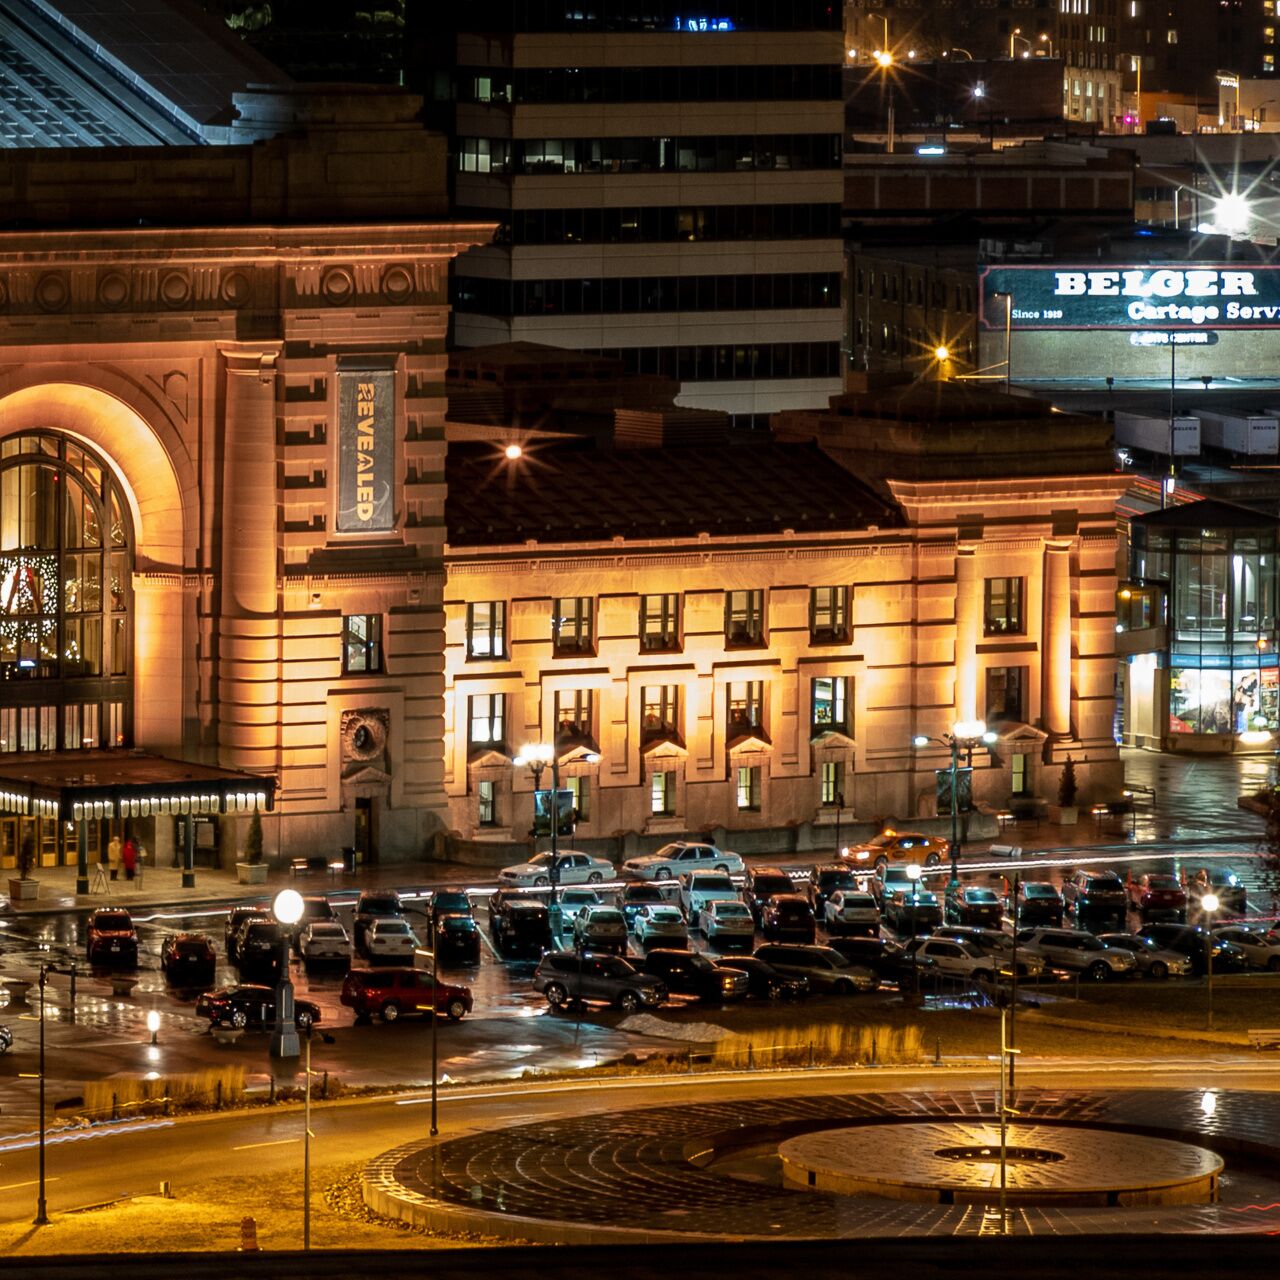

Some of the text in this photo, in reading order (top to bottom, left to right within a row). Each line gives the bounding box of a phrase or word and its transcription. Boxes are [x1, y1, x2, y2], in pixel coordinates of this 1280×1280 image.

[1054, 270, 1257, 297] BELGER
[1011, 309, 1063, 319] Since 1919
[1127, 301, 1280, 324] Cartage Serv
[356, 383, 376, 522] REVEALED
